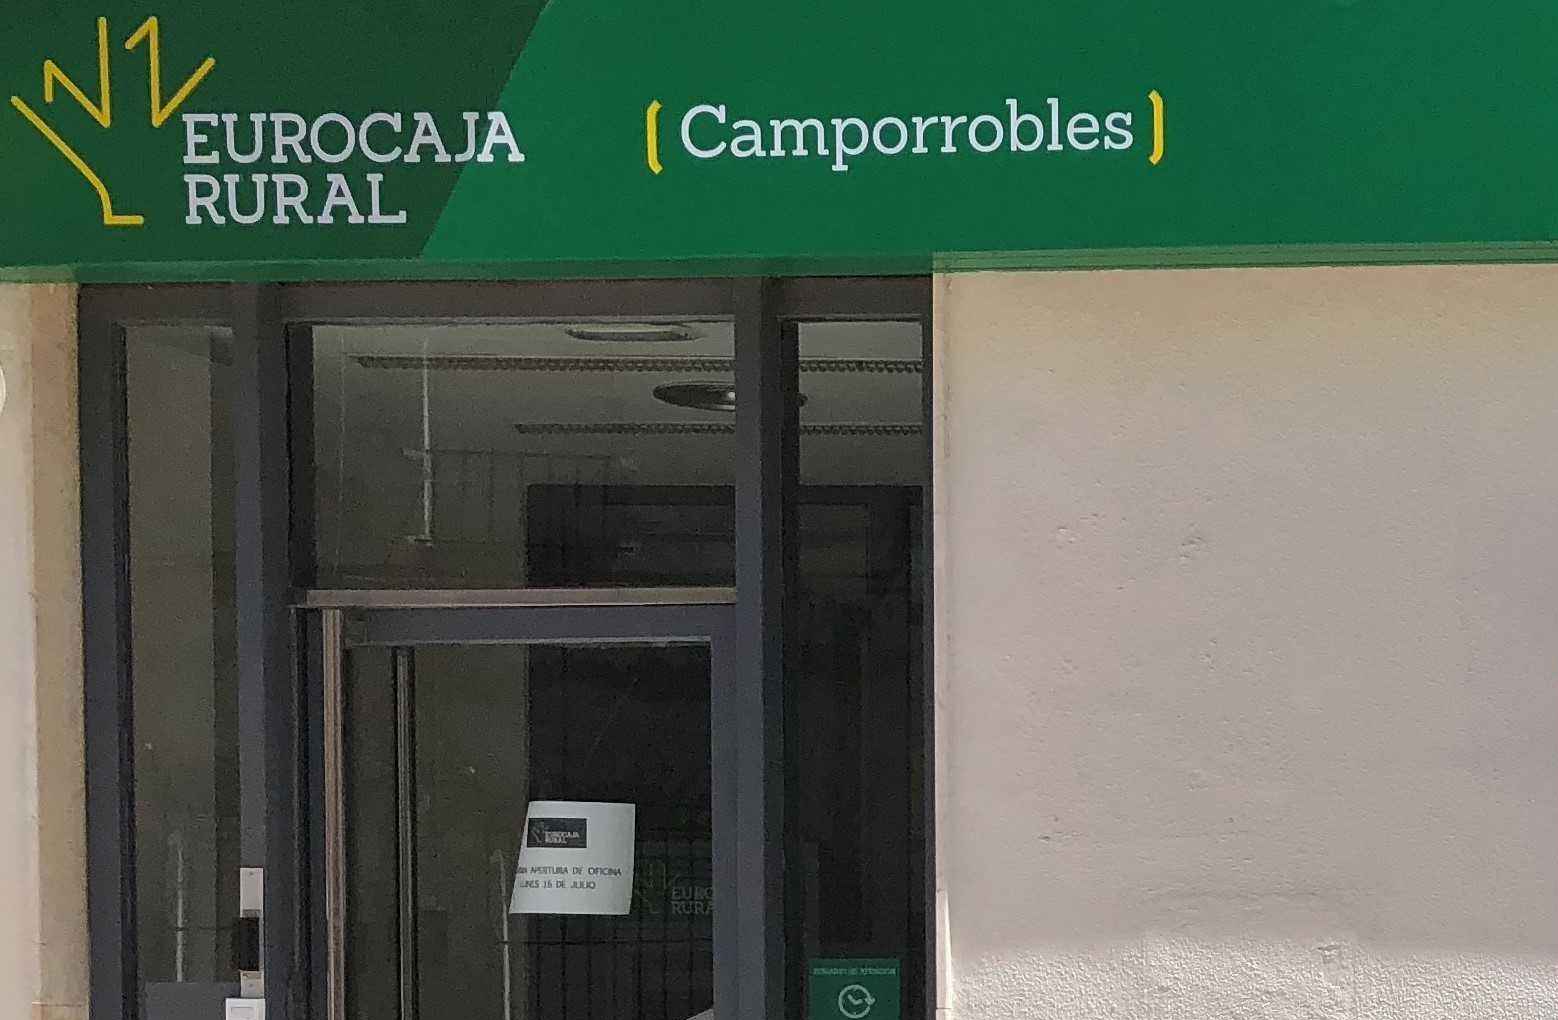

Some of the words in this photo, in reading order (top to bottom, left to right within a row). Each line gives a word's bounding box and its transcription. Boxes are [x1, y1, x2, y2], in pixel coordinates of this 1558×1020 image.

[182, 109, 525, 164] EUROCAJA
[185, 174, 407, 226] RURAL
[556, 881, 566, 889] DE
[570, 881, 596, 890] JULIO
[572, 866, 584, 875] DE
[587, 867, 622, 877] OFICINA
